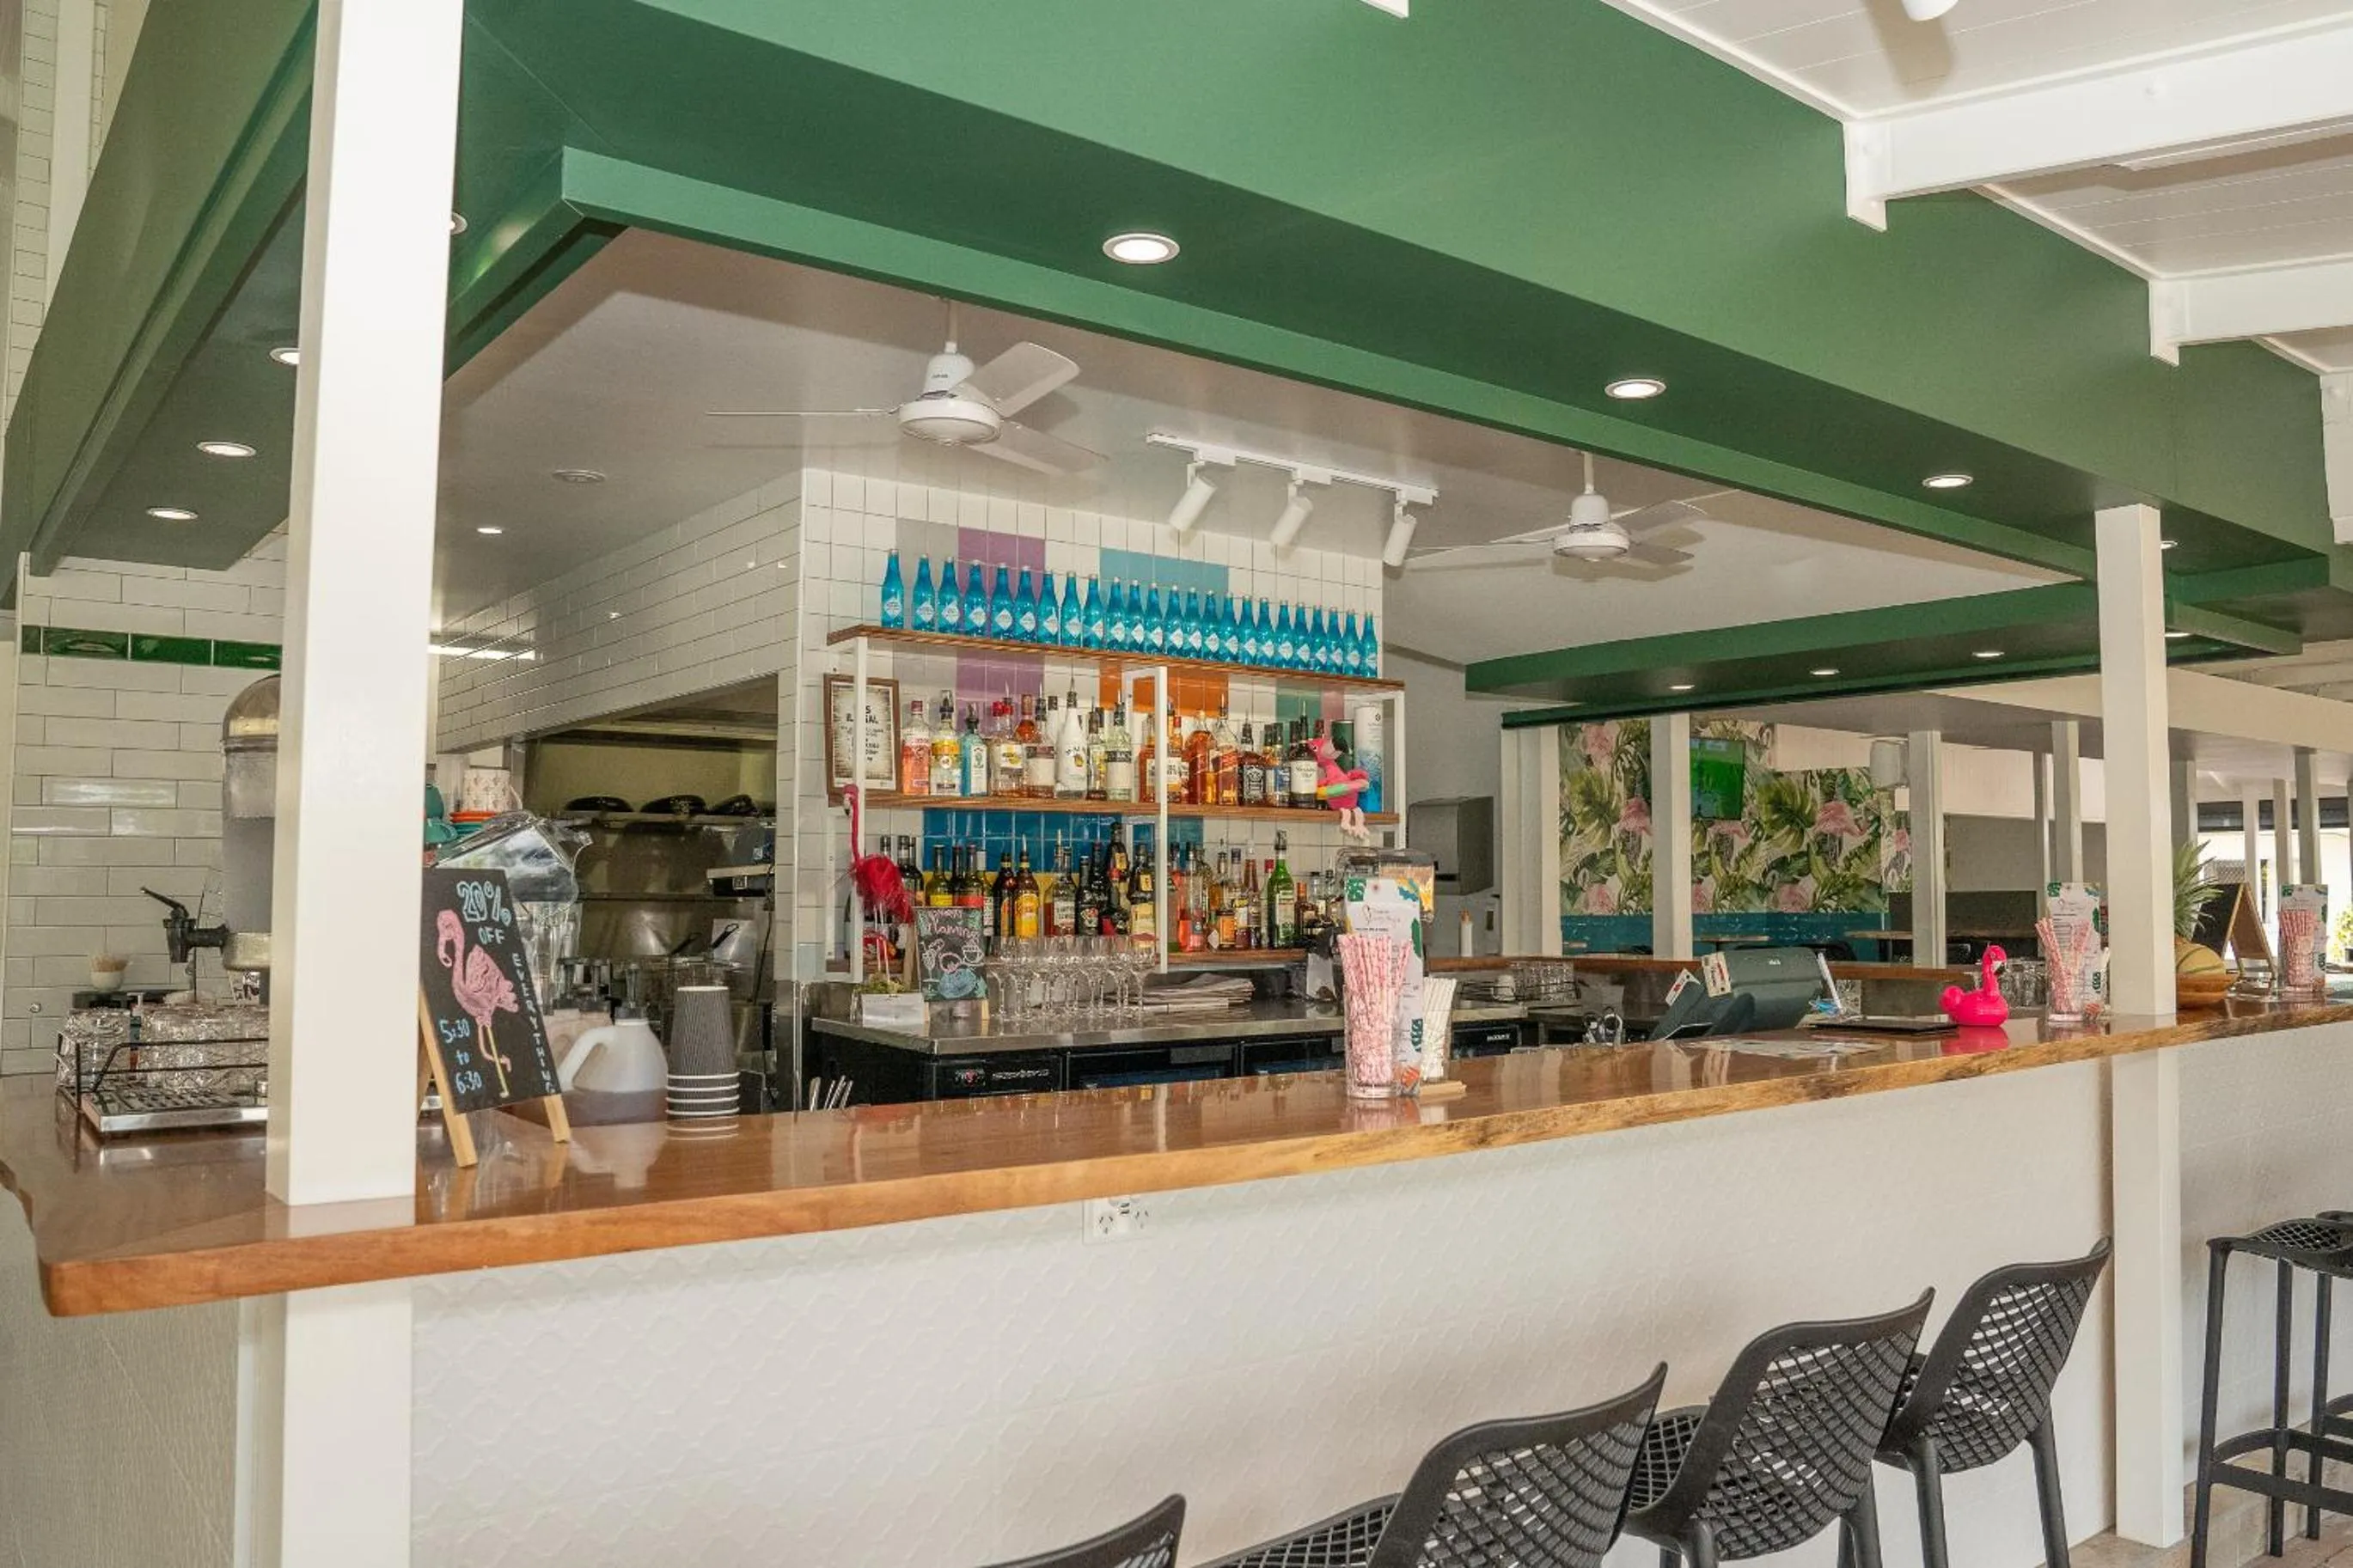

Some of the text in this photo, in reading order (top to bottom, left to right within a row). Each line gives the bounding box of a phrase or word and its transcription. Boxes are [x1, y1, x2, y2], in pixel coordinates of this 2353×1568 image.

[456, 881, 512, 927] 20%
[478, 926, 505, 944] OFF
[439, 1017, 470, 1043] 5:30
[512, 952, 556, 1094] EVERYTHING
[455, 1049, 470, 1065] to
[455, 1070, 482, 1094] 6:30
